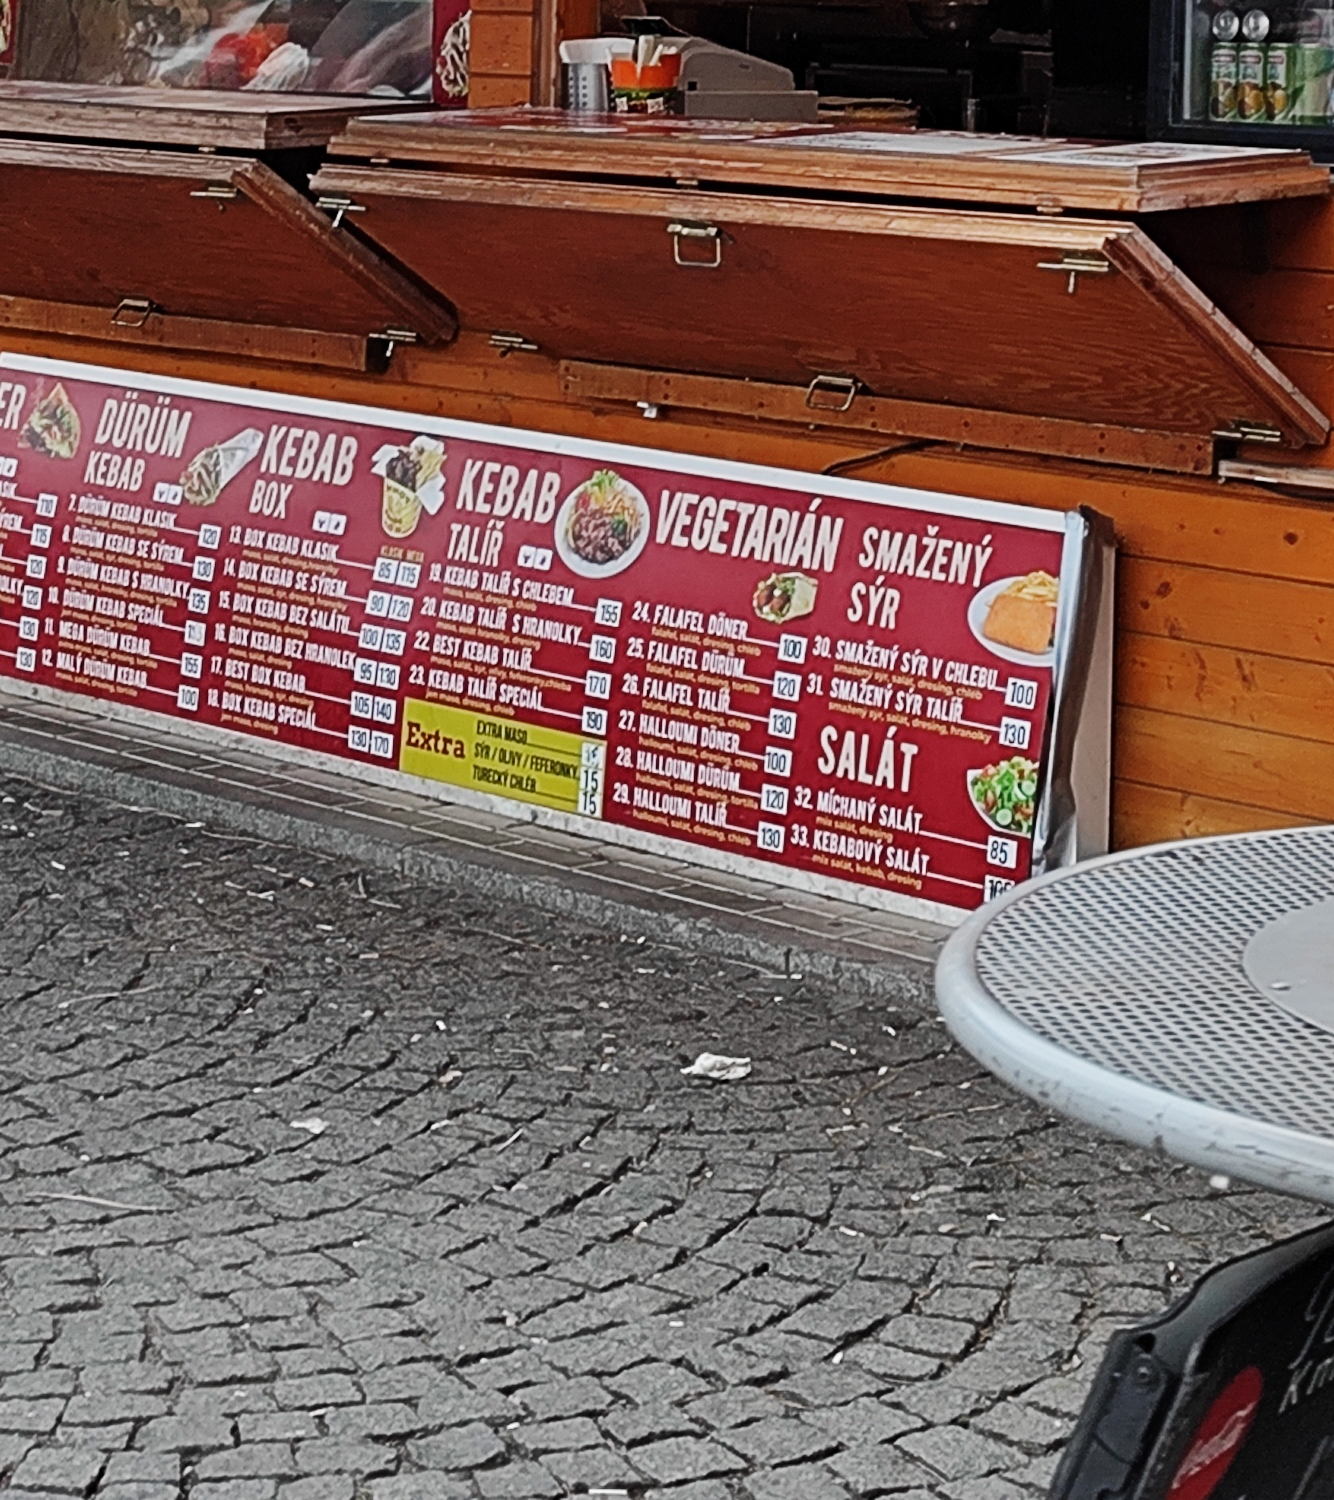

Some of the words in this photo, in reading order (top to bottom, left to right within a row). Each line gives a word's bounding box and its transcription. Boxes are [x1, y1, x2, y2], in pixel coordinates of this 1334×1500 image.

[94, 391, 192, 458] DÜRÜM
[260, 424, 358, 486] KEBAB
[83, 451, 145, 492] KEBAB
[249, 479, 293, 519] BOX
[455, 458, 561, 524] KEBAB
[446, 519, 506, 568] TALÍŘ
[656, 489, 844, 573] VEGETARIÁN
[858, 524, 993, 588] SMAŽENÝ
[443, 565, 478, 590] KEBAB
[481, 569, 511, 596] TALÍŘ
[511, 577, 520, 597] S
[522, 580, 574, 606] CHLEBEM
[601, 605, 619, 624] 155
[846, 574, 902, 631] SÝR
[420, 597, 437, 617] 20.
[439, 600, 474, 625] KEBAB
[478, 604, 508, 631] TALÍŘ
[511, 613, 520, 634] S
[522, 616, 583, 646] HRANOLKY
[594, 641, 613, 660] 160
[632, 601, 650, 624] 24.
[653, 605, 704, 634] FALAFEL
[708, 611, 749, 641] DÖNER
[783, 640, 802, 660] 100
[225, 659, 250, 681] BEST
[251, 664, 271, 685] BOX
[273, 668, 306, 694] KEBAB
[375, 701, 392, 720] 140
[432, 634, 460, 658] BEST
[462, 640, 500, 666] KEBAB
[502, 643, 533, 671] TALÍŘ
[588, 676, 607, 695] 170
[627, 637, 644, 660] 25.
[647, 641, 698, 670] FALAFEL
[701, 648, 745, 678] DÜRÜM
[777, 677, 796, 697] 120
[812, 634, 832, 658] 30.
[835, 640, 900, 672] SMAŽENÝ
[900, 649, 928, 677] SÝR
[931, 658, 944, 679] V
[944, 661, 999, 692] CHLEBU
[1009, 681, 1035, 707] 100
[409, 665, 425, 687] 23.
[428, 669, 465, 694] KEBAB
[467, 675, 497, 701] TALÍŘ
[499, 686, 543, 711] SPECIÁL
[586, 711, 602, 731] 190
[622, 673, 640, 695] 26.
[643, 677, 694, 706] FALAFEL
[697, 687, 731, 713] TALÍŘ
[772, 714, 792, 735] 130
[829, 677, 894, 710] SMAŽENÝ
[894, 686, 922, 716] SÝR
[925, 694, 963, 724] TALÍŘ
[1003, 722, 1026, 747] 130
[406, 722, 466, 759] Extra
[618, 709, 636, 733] 27.
[639, 713, 698, 746] HALLOUMI
[700, 726, 740, 754] DÖNER
[766, 752, 786, 773] 100
[817, 724, 919, 793] SALÁT
[582, 793, 597, 815] 15
[583, 770, 598, 792] 15
[616, 746, 634, 768] 28.
[636, 750, 695, 782] HALLOUMI
[697, 762, 741, 792] DÜRÜM
[766, 790, 785, 811] 120
[613, 782, 631, 805] 29.
[633, 787, 691, 819] HALLOUMI
[694, 800, 727, 827] TALÍŘ
[761, 828, 781, 849] 130
[793, 785, 813, 811] 32.
[817, 787, 877, 824] MÍCHANÝ
[879, 804, 923, 834] SALÁT
[990, 840, 1009, 866] 85
[790, 823, 809, 848] 33.
[813, 829, 884, 867] KEBABOVÝ
[885, 846, 930, 877] SALÁT
